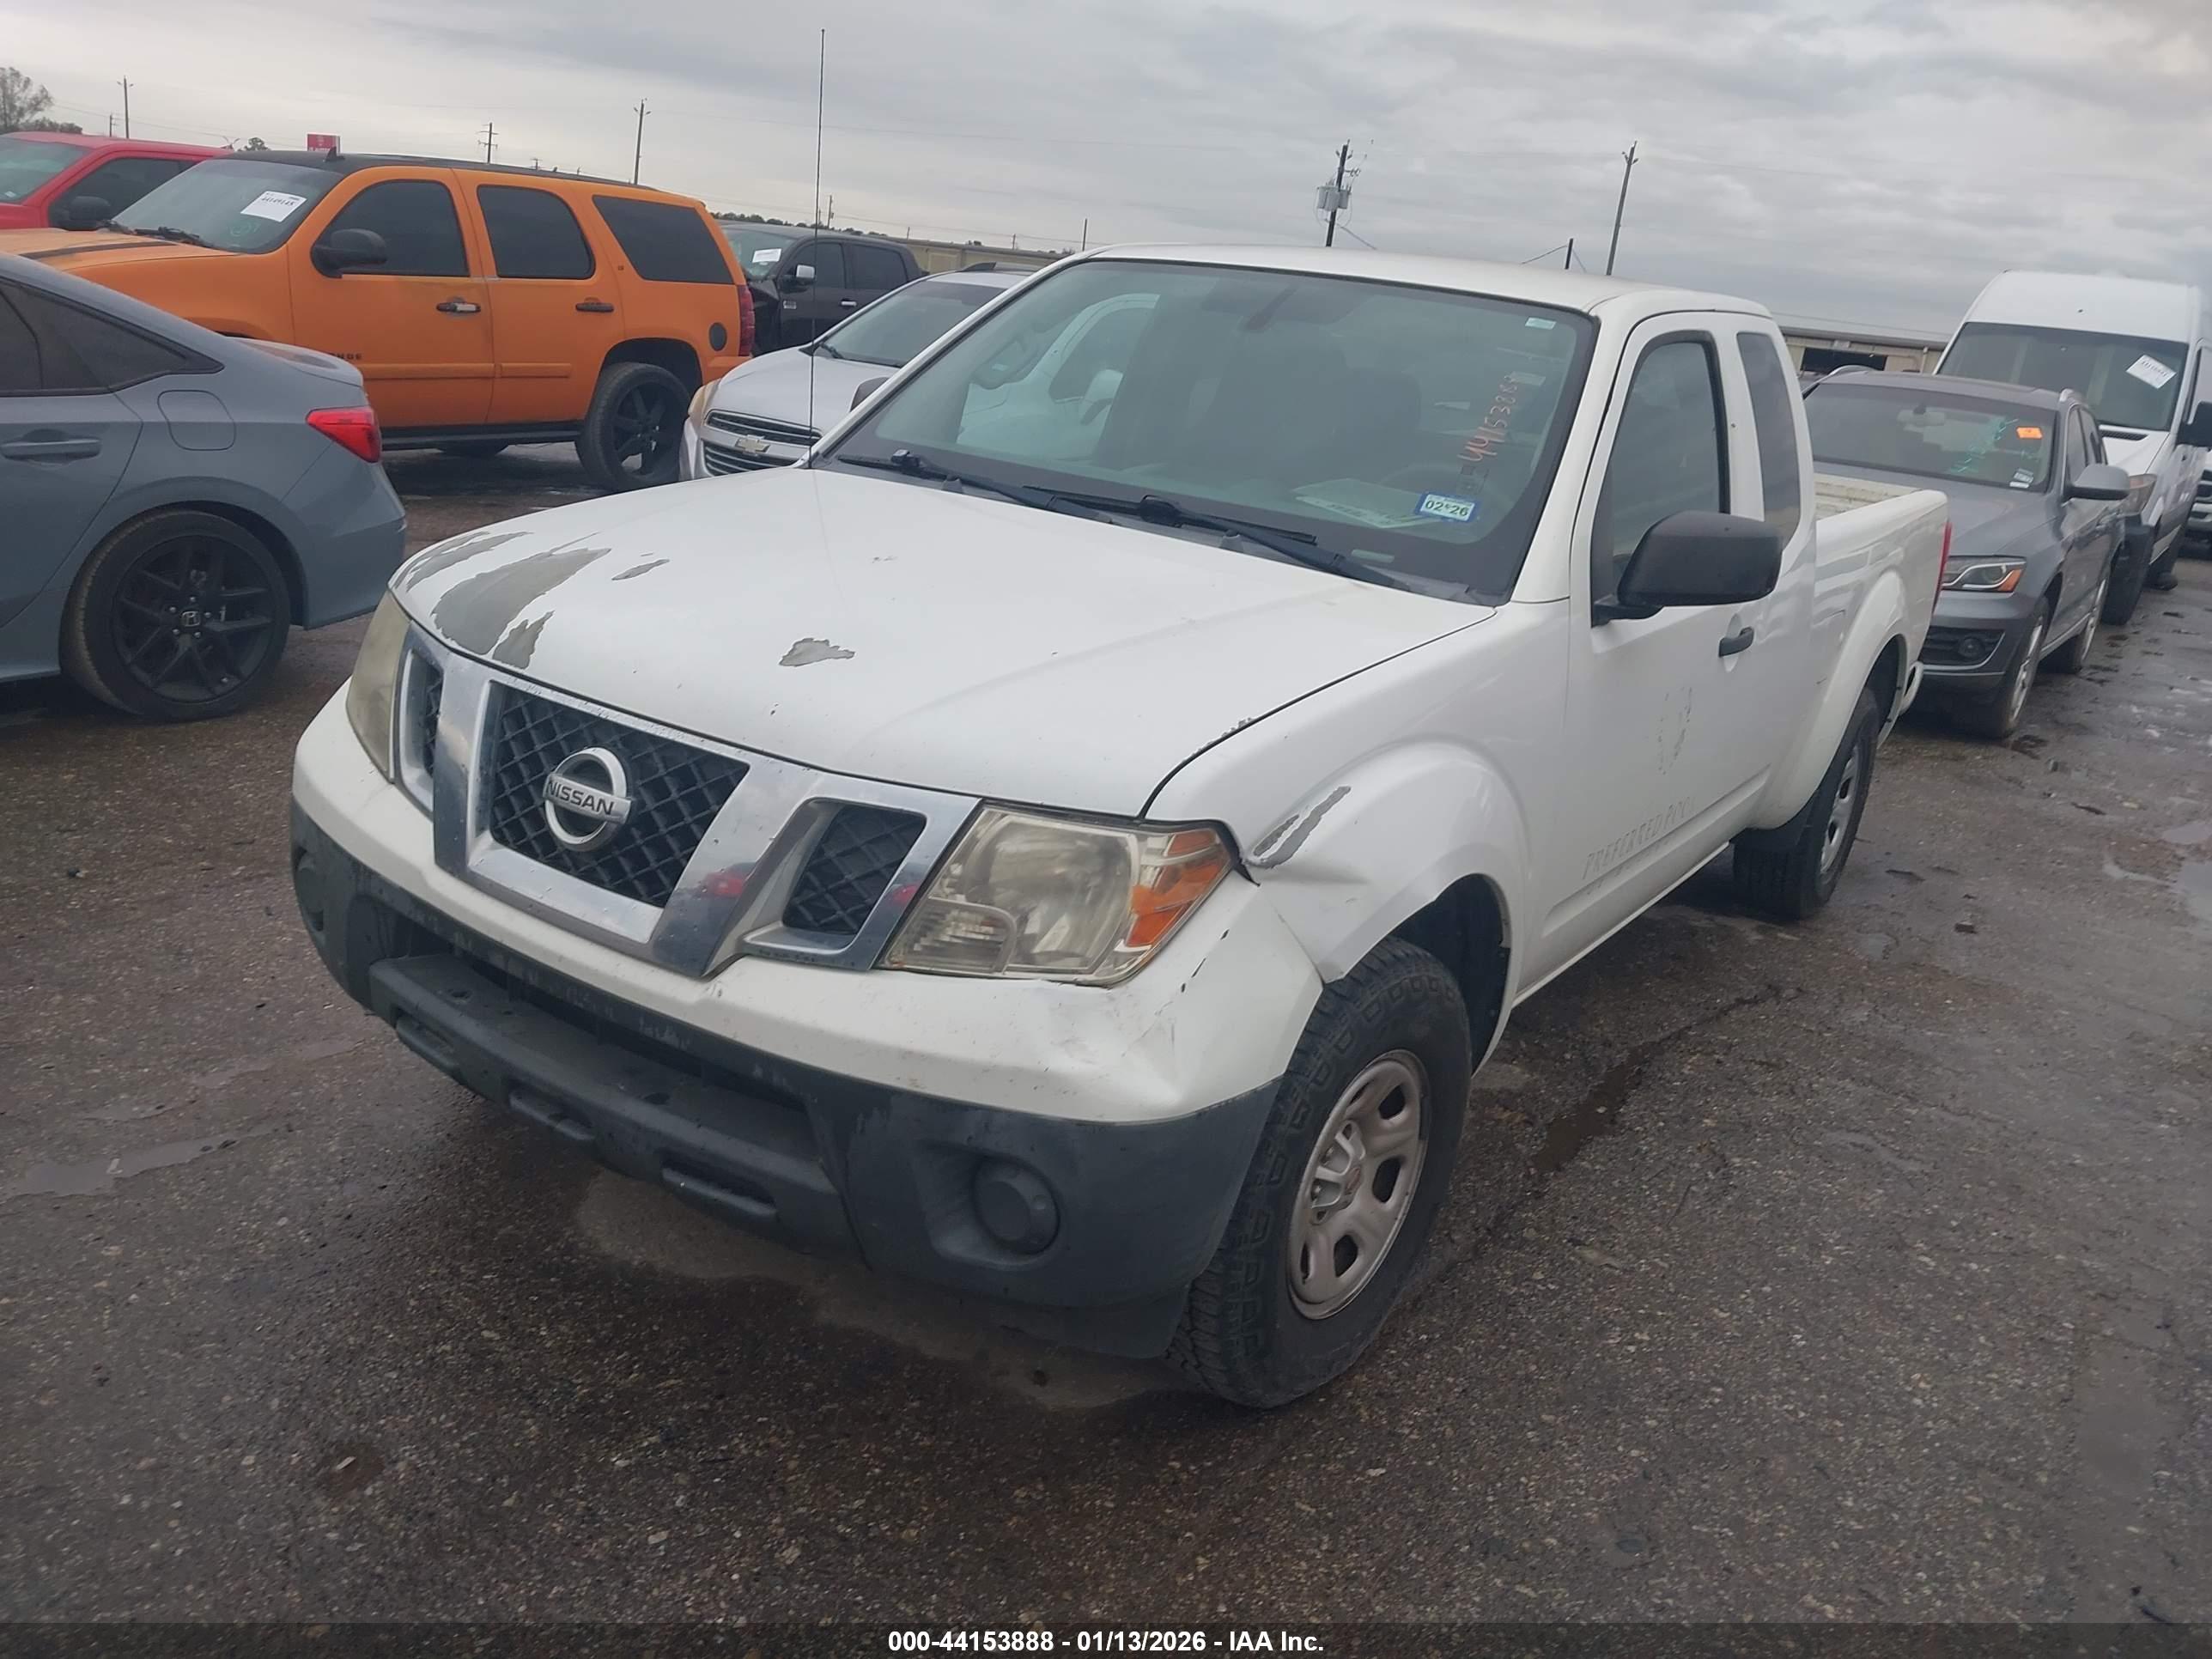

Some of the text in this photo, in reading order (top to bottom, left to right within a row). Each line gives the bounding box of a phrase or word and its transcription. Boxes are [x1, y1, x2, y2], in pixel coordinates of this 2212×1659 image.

[1425, 500, 1443, 512] 02
[1449, 505, 1469, 517] 26
[546, 780, 615, 815] NISSAN
